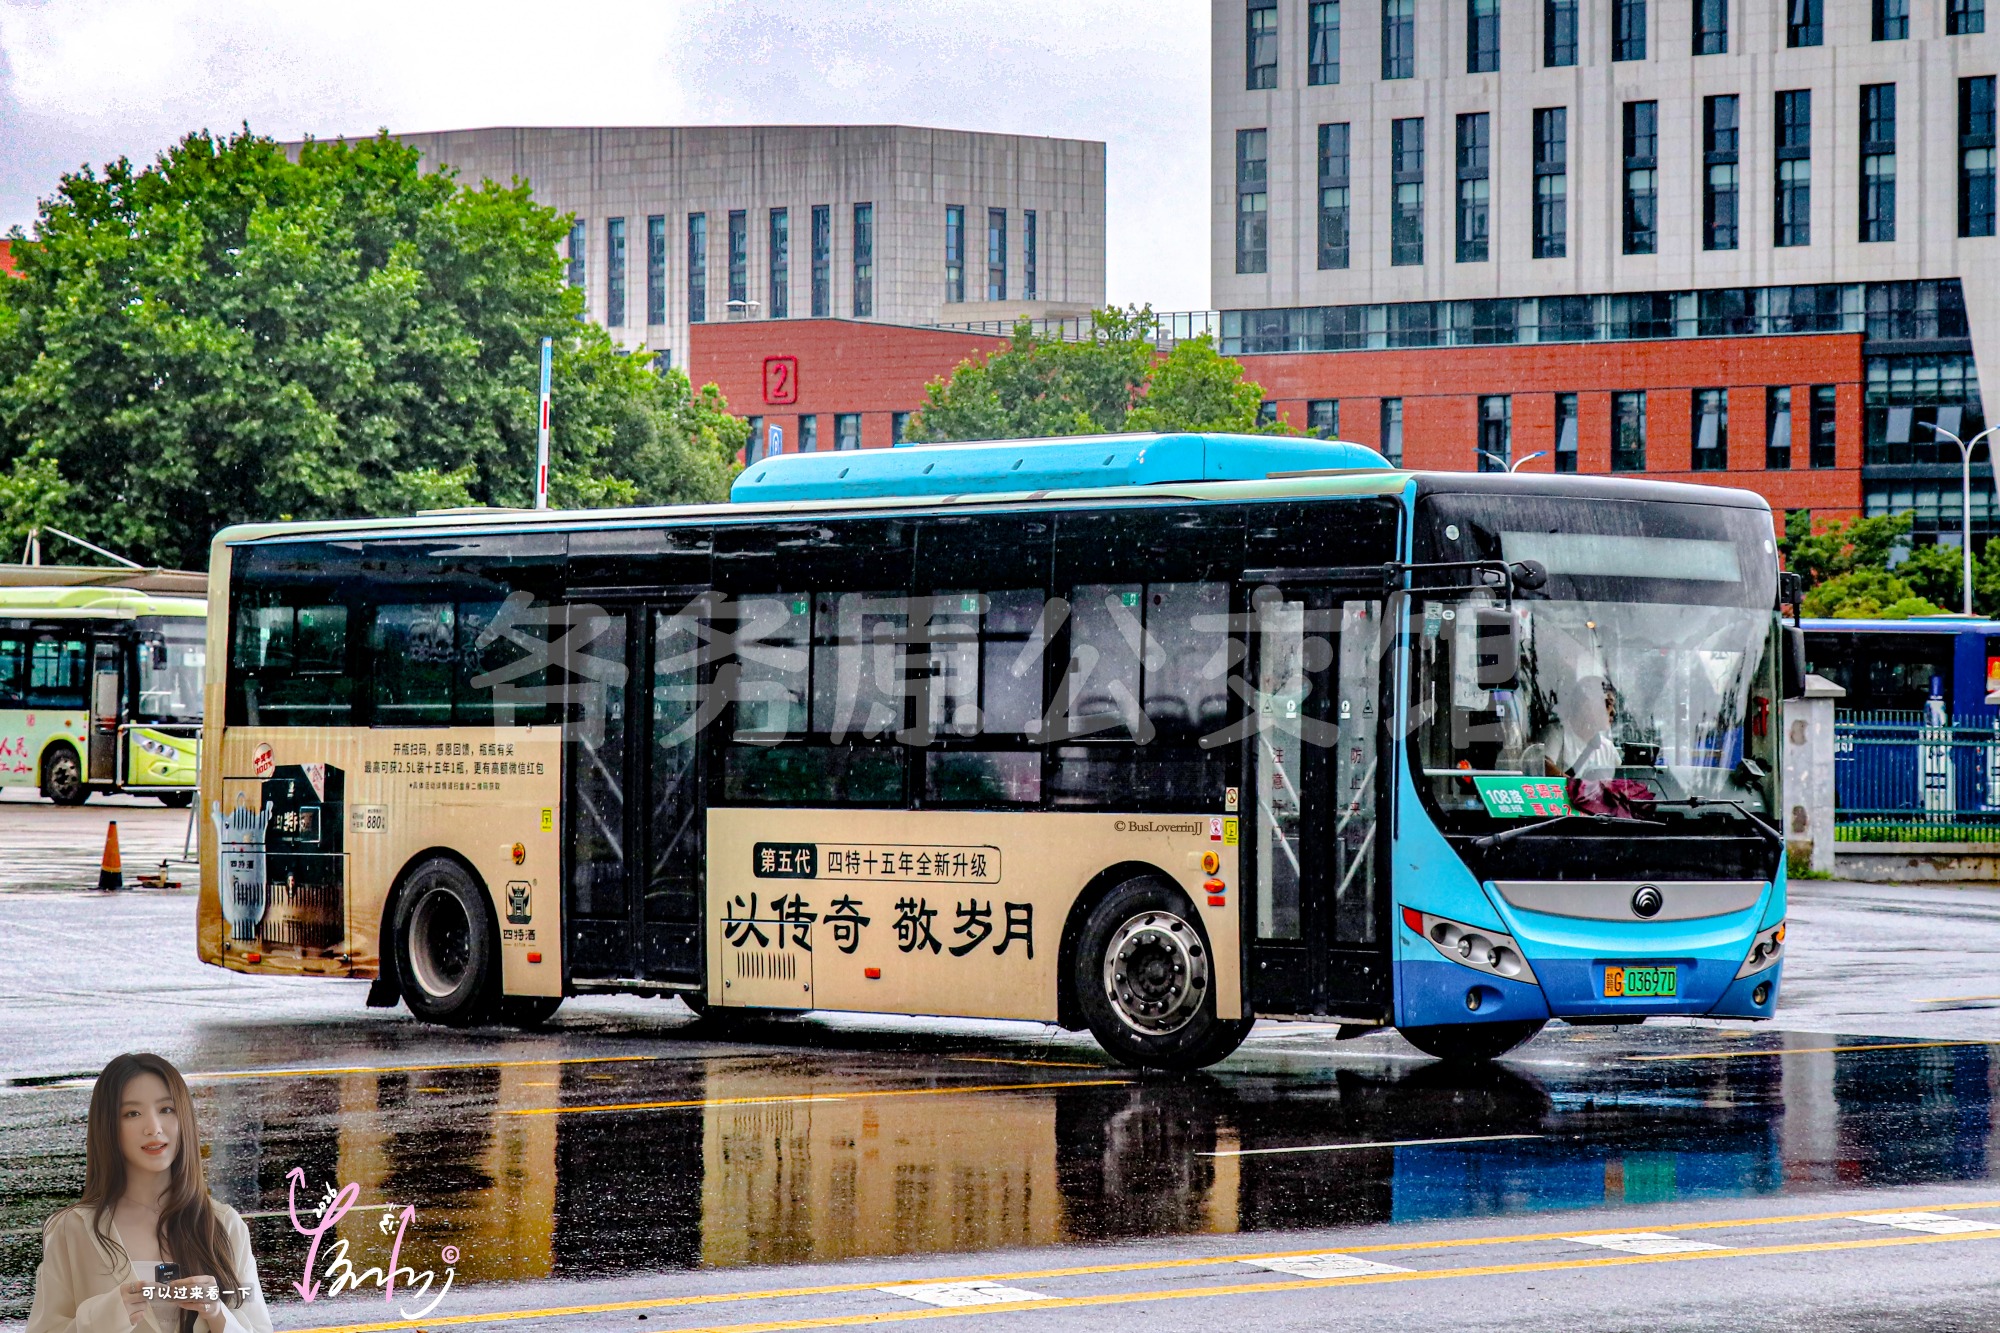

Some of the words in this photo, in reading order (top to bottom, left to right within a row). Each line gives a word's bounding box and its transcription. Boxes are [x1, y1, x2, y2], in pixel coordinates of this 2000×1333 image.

[772, 363, 788, 398] 2
[1521, 783, 1565, 800] 空调开
[366, 815, 382, 829] 880
[760, 848, 811, 874] 第五代
[827, 851, 987, 878] 四特十五年全新升级
[503, 929, 536, 941] 四特酒
[724, 892, 871, 954] 以传奇
[892, 896, 1034, 960] 敬岁月
